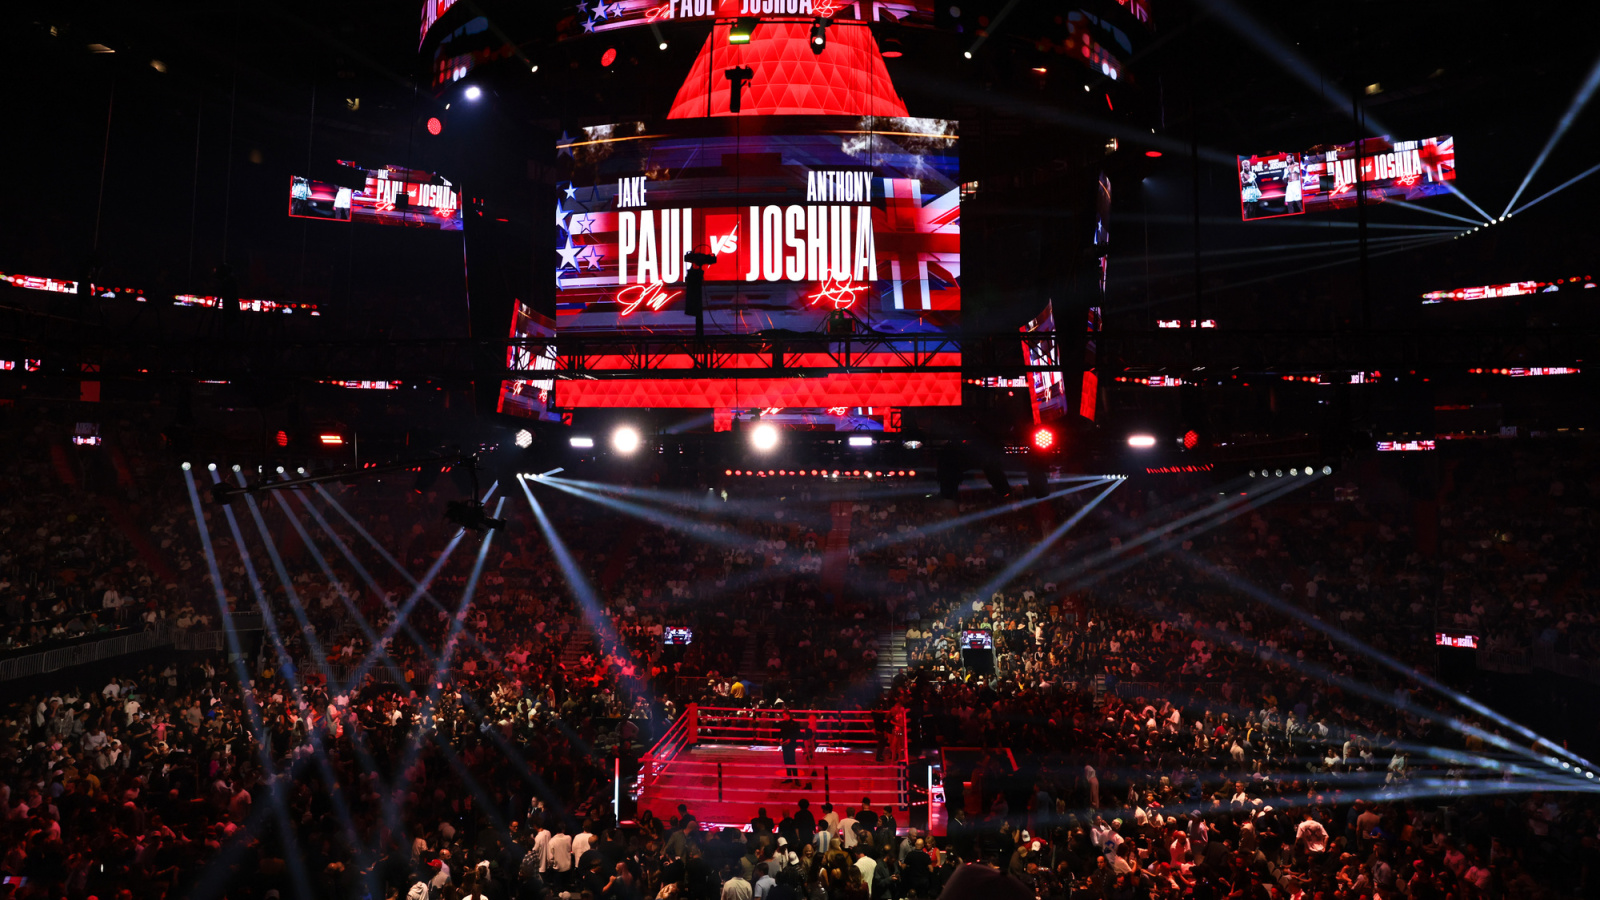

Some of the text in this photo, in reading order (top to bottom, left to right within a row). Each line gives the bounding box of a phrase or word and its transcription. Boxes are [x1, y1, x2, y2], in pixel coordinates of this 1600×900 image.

[1374, 149, 1423, 181] JOSHUA
[417, 183, 457, 210] JOSHUA
[617, 171, 873, 207] JAKE ANTHONY
[745, 204, 878, 282] JOSHUA
